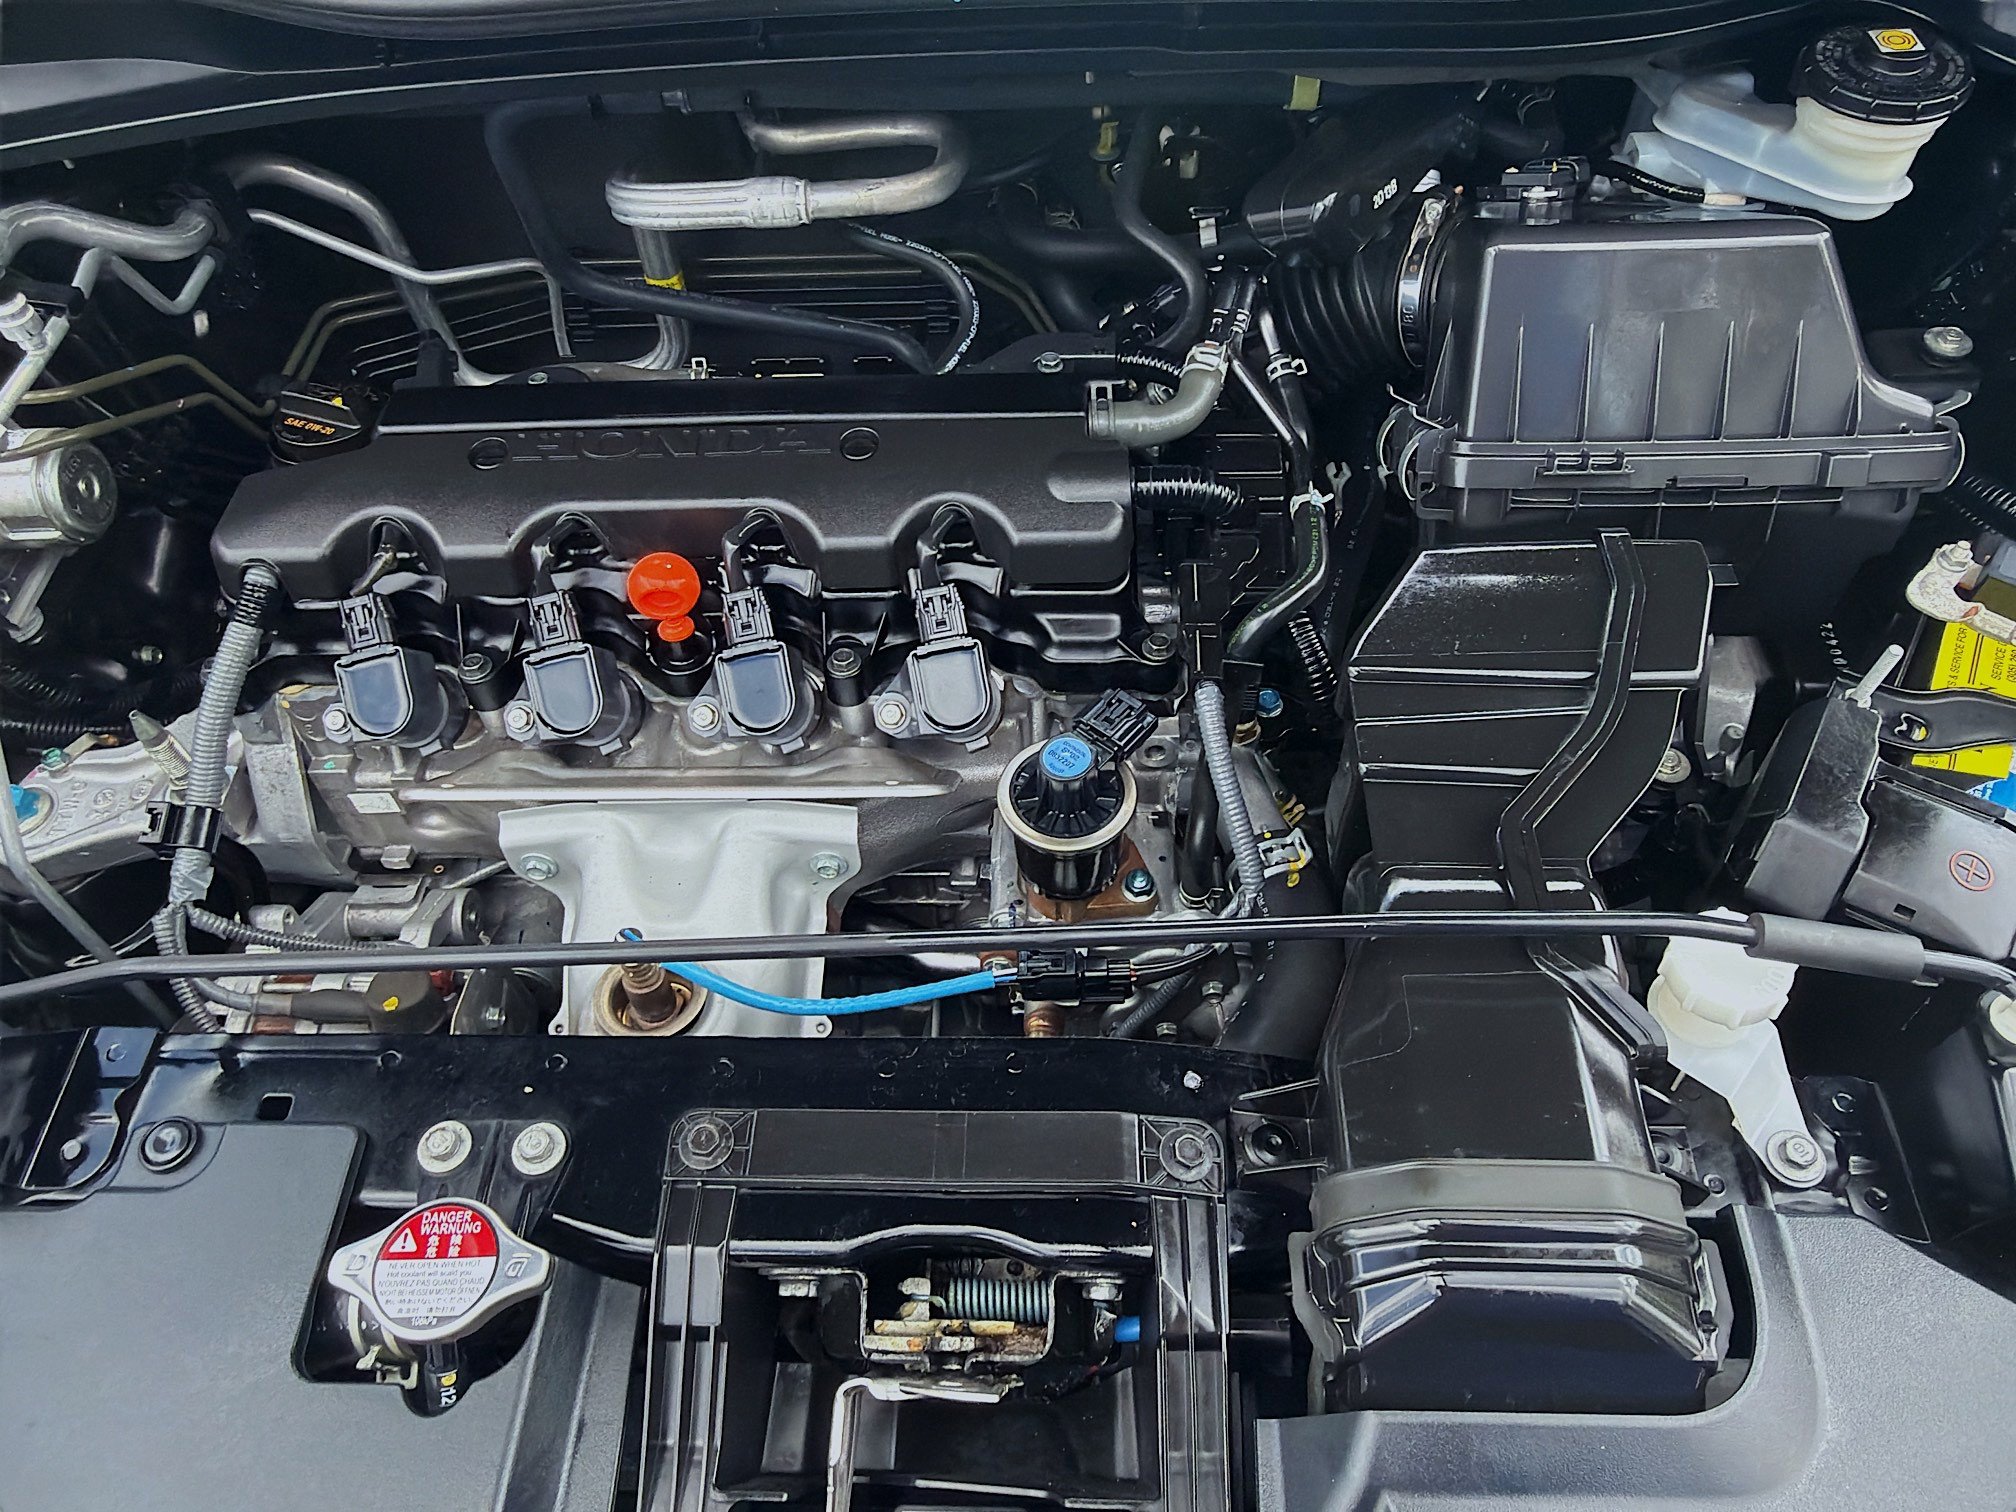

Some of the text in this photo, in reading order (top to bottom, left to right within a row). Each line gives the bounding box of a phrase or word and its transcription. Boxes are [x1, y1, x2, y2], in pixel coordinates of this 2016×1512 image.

[284, 417, 336, 435] SAE 0W-20
[511, 427, 832, 462] HONDA
[1950, 643, 1964, 674] SERVICE
[1957, 627, 1968, 644] FOR
[1990, 646, 2007, 681] SERVICE
[422, 1210, 473, 1224] DANGER
[420, 1221, 482, 1235] WARNUNG
[388, 1259, 481, 1270] NEVER OPEN WHEN HOT
